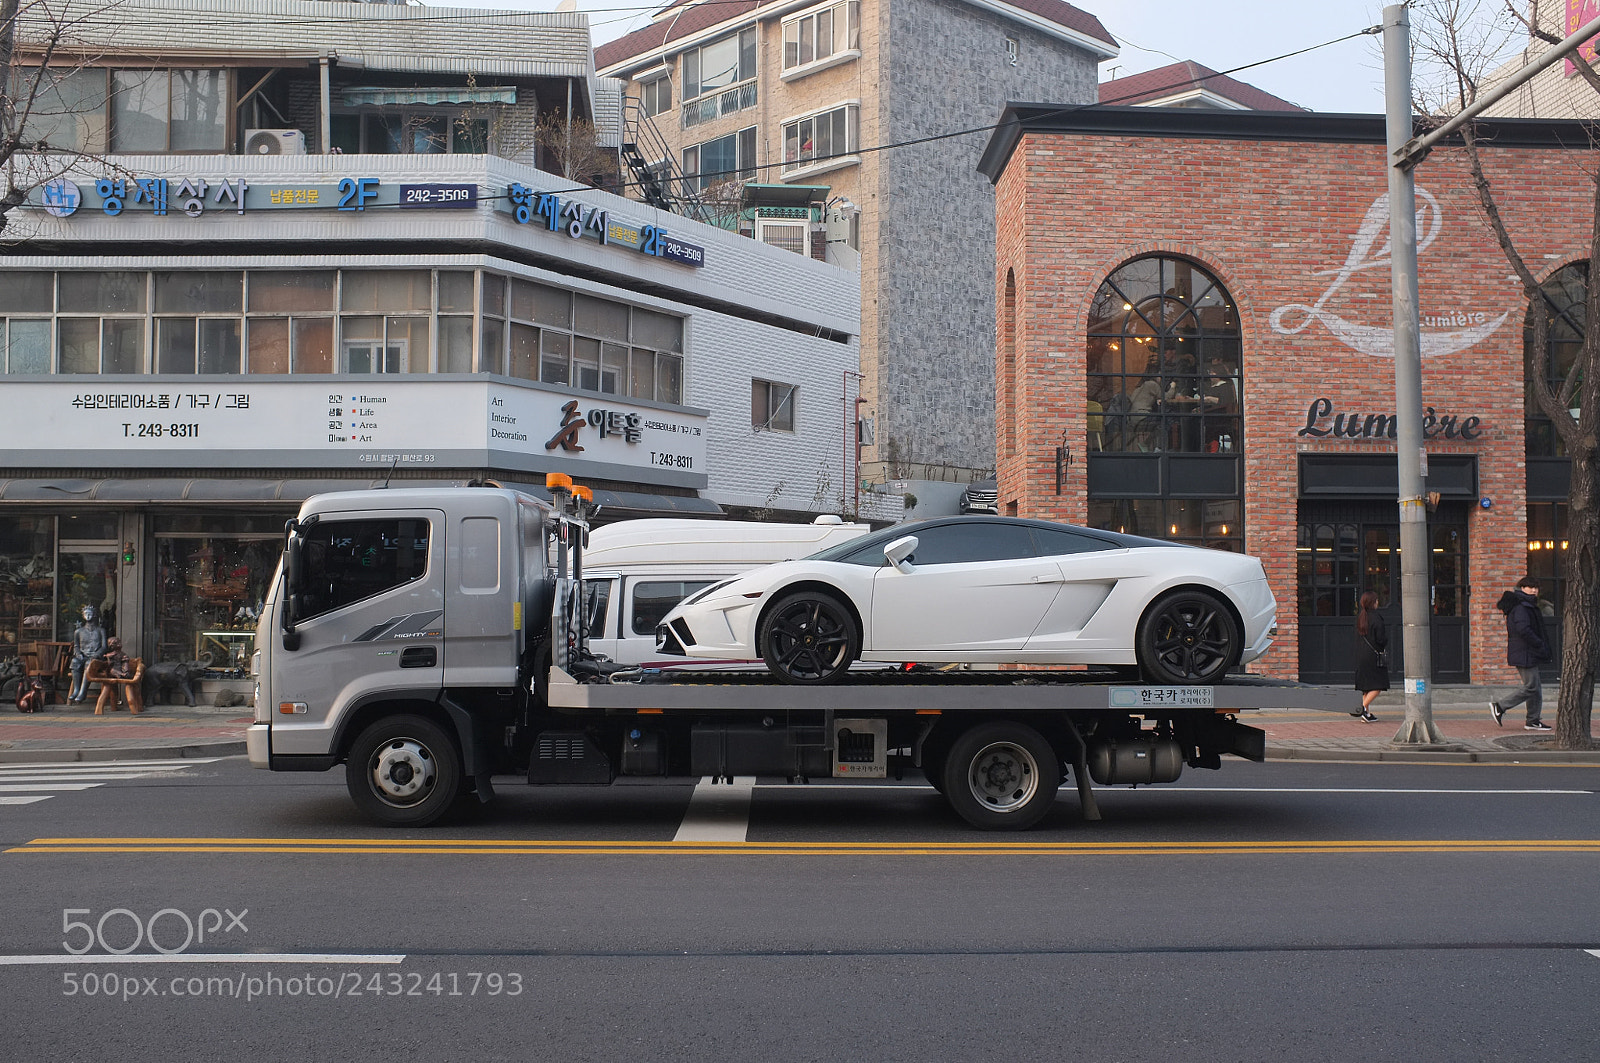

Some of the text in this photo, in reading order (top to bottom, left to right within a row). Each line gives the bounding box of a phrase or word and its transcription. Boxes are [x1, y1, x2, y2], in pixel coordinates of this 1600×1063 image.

[95, 177, 469, 217] 형제상사 납품전문 2F 242-3509
[507, 182, 702, 262] 형제상사 납품전문 2F 242-3509
[1419, 310, 1485, 327] umière
[72, 394, 170, 409] 수입인테리어소품
[186, 394, 210, 409] 가구
[225, 394, 250, 409] 그림
[328, 394, 387, 404] 인간 Human
[491, 396, 503, 407] Art
[359, 408, 374, 416] Life
[491, 412, 516, 425] Interior
[1298, 397, 1482, 440] Lumère
[138, 423, 200, 437] 243-8311
[328, 421, 377, 429] 공간 Area
[588, 408, 643, 444] 아트홀
[359, 434, 372, 442] Art
[491, 428, 527, 442] Decoration
[424, 454, 435, 462] 93
[659, 453, 693, 468] 243-8311
[1141, 689, 1178, 702] 한국카
